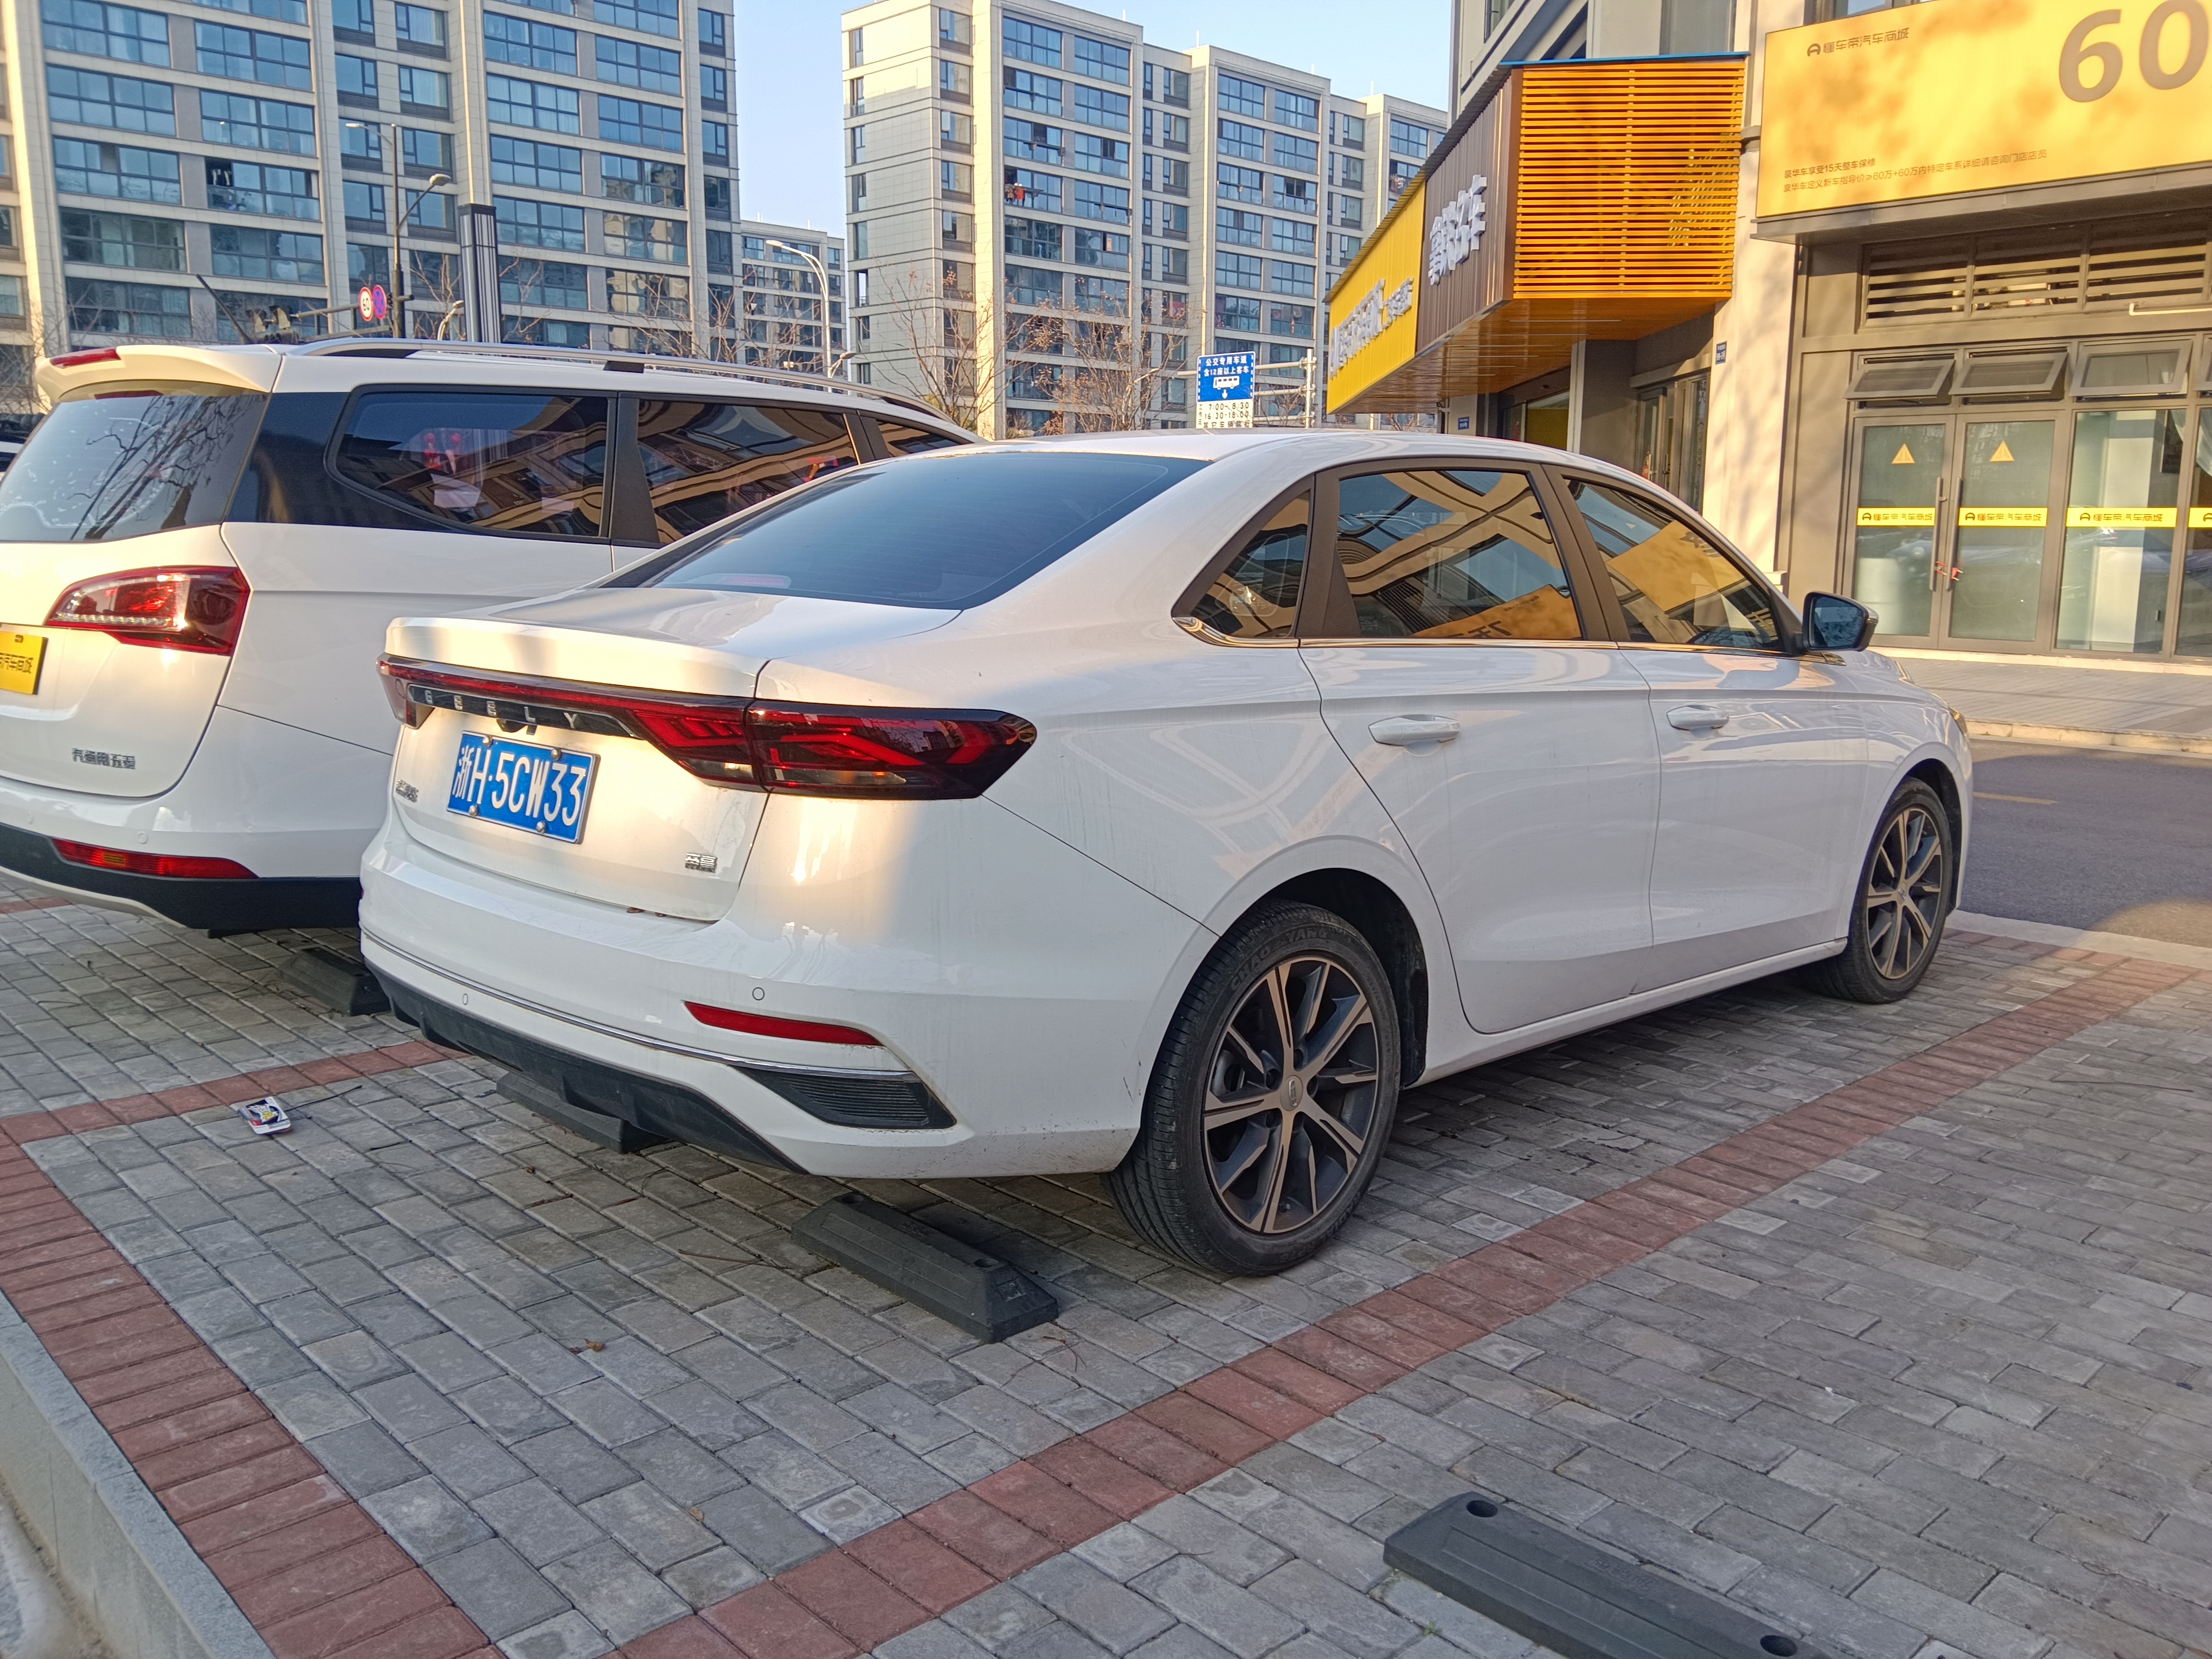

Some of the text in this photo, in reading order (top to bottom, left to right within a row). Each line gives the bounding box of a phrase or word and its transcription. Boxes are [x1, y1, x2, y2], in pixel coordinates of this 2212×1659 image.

[2059, 0, 2209, 102] 60
[1204, 365, 1249, 377] 含12座以上客车
[1205, 355, 1247, 366] 公交专用车道
[425, 690, 577, 729] GEELY
